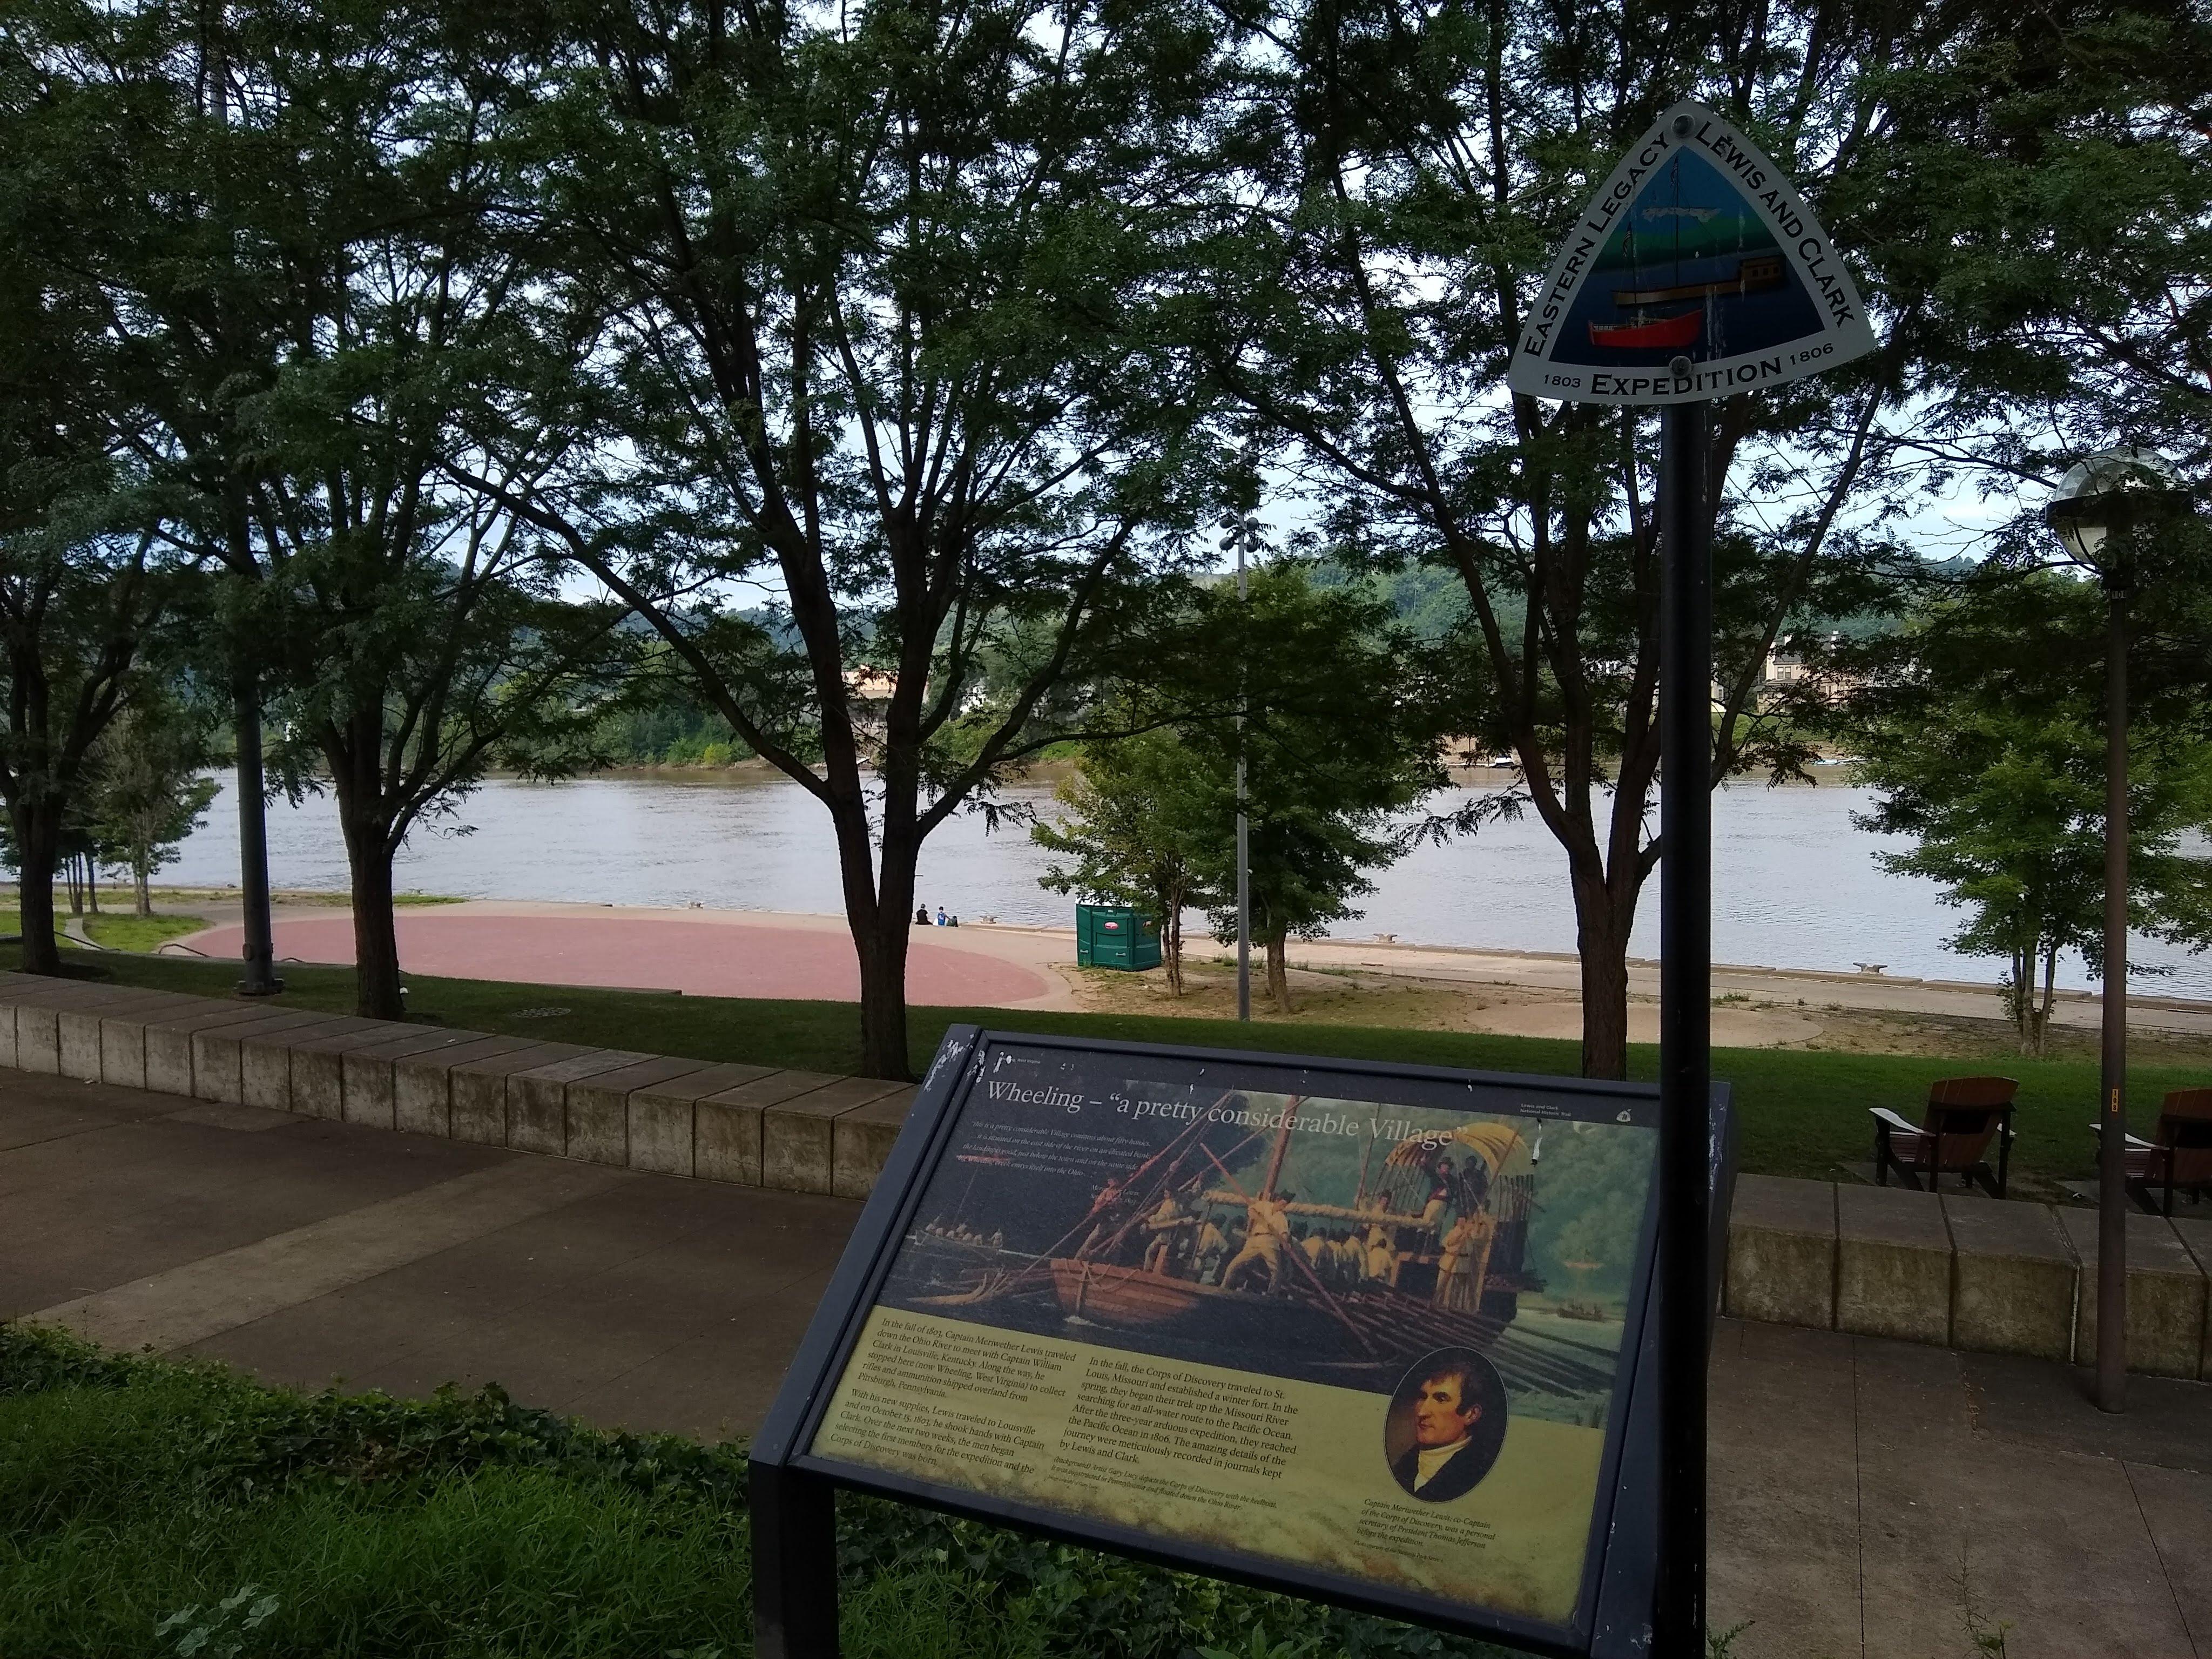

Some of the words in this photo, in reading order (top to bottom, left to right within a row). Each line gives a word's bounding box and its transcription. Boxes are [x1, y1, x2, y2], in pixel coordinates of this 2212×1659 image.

[1523, 237, 1595, 357] EASTERN
[1587, 131, 1669, 234] LEGACY
[1695, 121, 1766, 189] LEWIS
[1759, 189, 1803, 238] AND
[1798, 238, 1855, 328] CLARK
[1544, 374, 1580, 388] 1803
[1590, 356, 1782, 395] EXPEDITION
[1789, 343, 1833, 366] 1806
[989, 1081, 1084, 1113] Wheeling
[1132, 1100, 1203, 1125] pretty
[1208, 1107, 1359, 1136] considerable
[1369, 1117, 1468, 1151] Village”
[872, 1340, 893, 1350] Clark
[902, 1345, 939, 1361] Louisville,
[978, 1360, 1001, 1373] Along
[1002, 1365, 1015, 1374] the
[1016, 1370, 1031, 1379] way,
[1034, 1371, 1045, 1380] he
[876, 1329, 898, 1339] down
[898, 1334, 911, 1342] the
[911, 1336, 931, 1346] Ohio
[932, 1339, 952, 1350] River
[962, 1347, 981, 1355] meet
[981, 1350, 1000, 1359] with
[1000, 1352, 1030, 1365] Captain
[1032, 1358, 1062, 1371] William
[881, 1318, 890, 1326] In
[891, 1320, 903, 1328] the
[904, 1322, 916, 1331] fall
[944, 1330, 974, 1341] Captain
[975, 1336, 1020, 1350] Meriwether
[1020, 1344, 1043, 1355] Lewis
[1044, 1350, 1076, 1361] traveled
[862, 1362, 881, 1371] rifles
[881, 1366, 897, 1374] and
[896, 1370, 942, 1384] ammunition
[942, 1378, 974, 1391] shipped
[973, 1386, 1008, 1397] overland
[1008, 1391, 1028, 1401] from
[867, 1352, 897, 1363] stopped
[897, 1357, 914, 1366] here
[914, 1360, 935, 1371] (now
[975, 1372, 994, 1382] West
[995, 1375, 1029, 1391] Virginia)
[1039, 1386, 1066, 1396] collect
[898, 1380, 946, 1397] Pennsylvania.
[1085, 1368, 1109, 1381] Louis,
[1112, 1373, 1149, 1387] Missouri
[1149, 1381, 1166, 1390] and
[1166, 1385, 1214, 1399] established
[1221, 1394, 1250, 1405] winter
[1251, 1398, 1268, 1409] fort.
[1272, 1402, 1282, 1411] In
[1283, 1405, 1298, 1414] the
[1089, 1357, 1098, 1365] In
[1100, 1359, 1112, 1368] the
[1114, 1361, 1128, 1373] fall,
[1130, 1365, 1144, 1374] the
[1145, 1367, 1171, 1380] Corps
[1172, 1372, 1182, 1380] of
[1184, 1373, 1225, 1390] Discovery
[1227, 1382, 1262, 1394] traveled
[1263, 1388, 1272, 1397] to
[1274, 1390, 1284, 1399] St.
[1076, 1394, 1115, 1408] searching
[1116, 1399, 1129, 1408] for
[1142, 1405, 1179, 1418] all-water
[1181, 1413, 1203, 1422] route
[1204, 1417, 1215, 1425] to
[1216, 1418, 1230, 1428] the
[1232, 1420, 1260, 1433] Pacific
[1262, 1426, 1292, 1440] Ocean.
[1081, 1382, 1107, 1394] spring,
[1109, 1386, 1128, 1398] they
[1129, 1389, 1154, 1401] began
[1155, 1394, 1175, 1405] their
[1176, 1399, 1194, 1408] trek
[1195, 1404, 1207, 1413] up
[1209, 1404, 1223, 1413] the
[1224, 1406, 1264, 1421] Missouri
[1265, 1414, 1289, 1426] River
[1059, 1440, 1069, 1451] by
[1071, 1442, 1096, 1454] Lewis
[1096, 1449, 1114, 1458] and
[1068, 1415, 1082, 1425] the
[1083, 1418, 1110, 1431] Pacific
[1111, 1424, 1138, 1436] Ocean
[1139, 1429, 1149, 1438] in
[1150, 1432, 1170, 1443] 1806.
[1175, 1436, 1190, 1446] The
[1191, 1442, 1228, 1456] amazing
[1229, 1446, 1258, 1460] details
[1259, 1453, 1270, 1462] of
[1271, 1455, 1286, 1465] the
[1072, 1403, 1094, 1414] After
[1095, 1408, 1108, 1418] the
[1110, 1411, 1152, 1426] three-year
[1153, 1420, 1188, 1433] arduous
[1189, 1428, 1237, 1445] expedition,
[1239, 1436, 1259, 1449] they
[1260, 1442, 1297, 1454] reached
[1063, 1427, 1095, 1442] journey
[1096, 1436, 1117, 1445] were
[1118, 1440, 1171, 1458] meticulously
[1173, 1451, 1212, 1464] recorded
[1213, 1457, 1223, 1466] in
[1224, 1459, 1260, 1474] journals
[1262, 1466, 1283, 1480] kept
